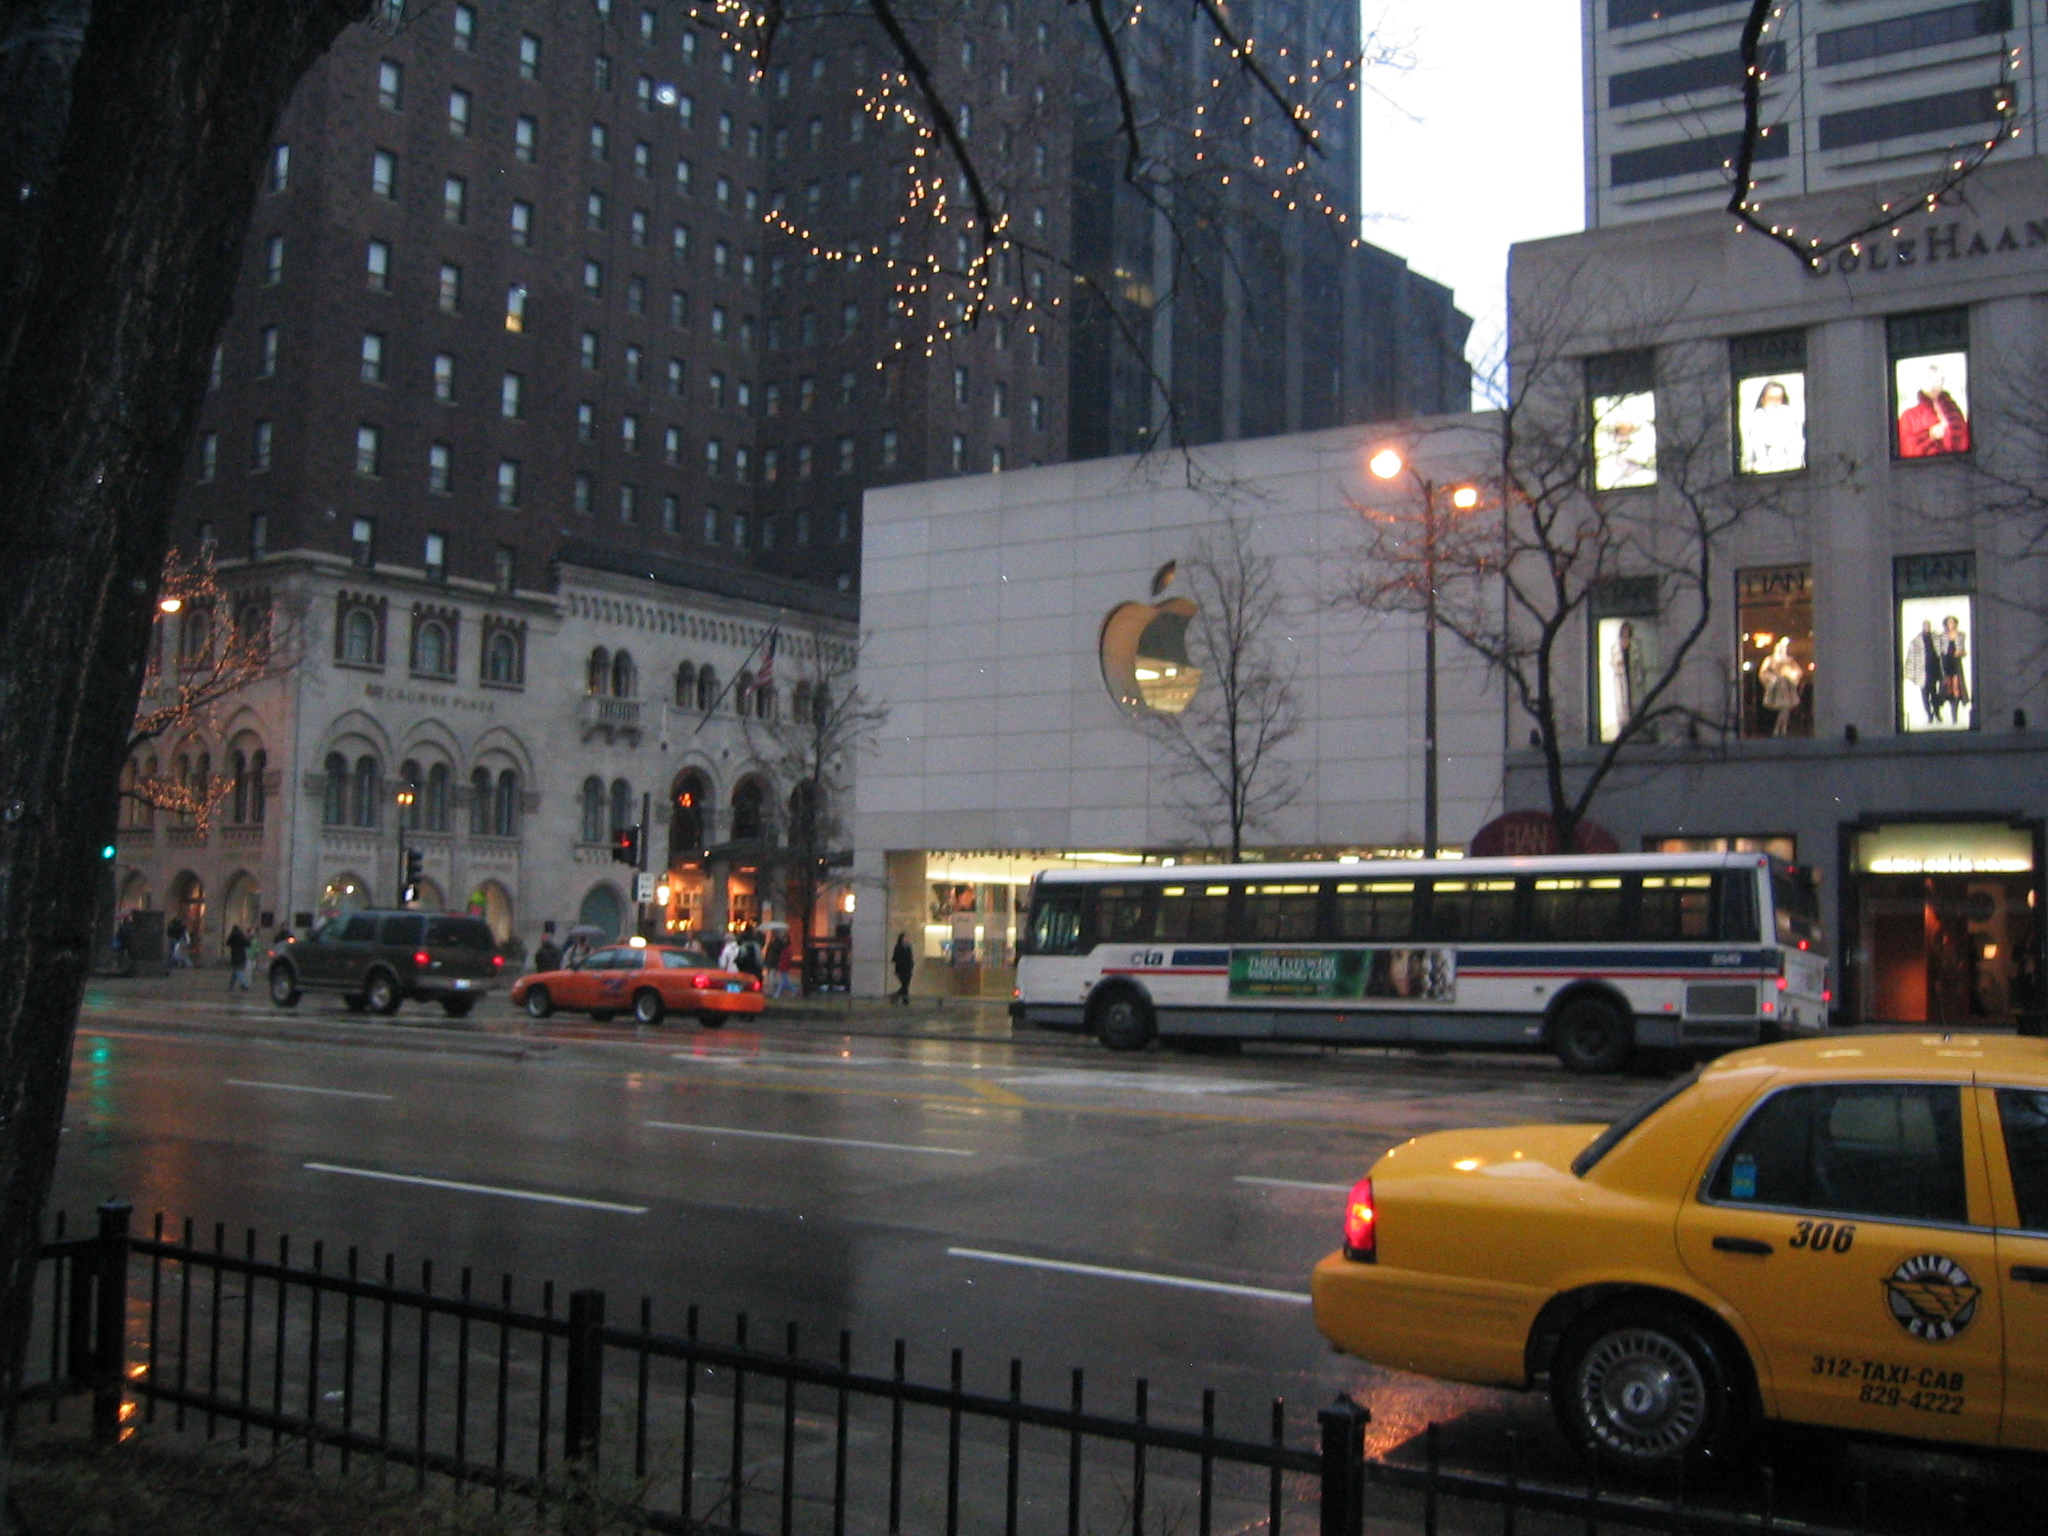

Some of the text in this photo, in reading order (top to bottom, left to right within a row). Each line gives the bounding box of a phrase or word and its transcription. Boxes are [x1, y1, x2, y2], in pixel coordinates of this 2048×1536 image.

[1130, 948, 1164, 965] cta
[1789, 1219, 1856, 1253] 306
[1893, 1253, 1970, 1286] YELLOW
[1907, 1318, 1955, 1341] CAB
[1811, 1355, 1965, 1392] 312-TAXI-CAB
[1859, 1383, 1966, 1416] 829-4222
